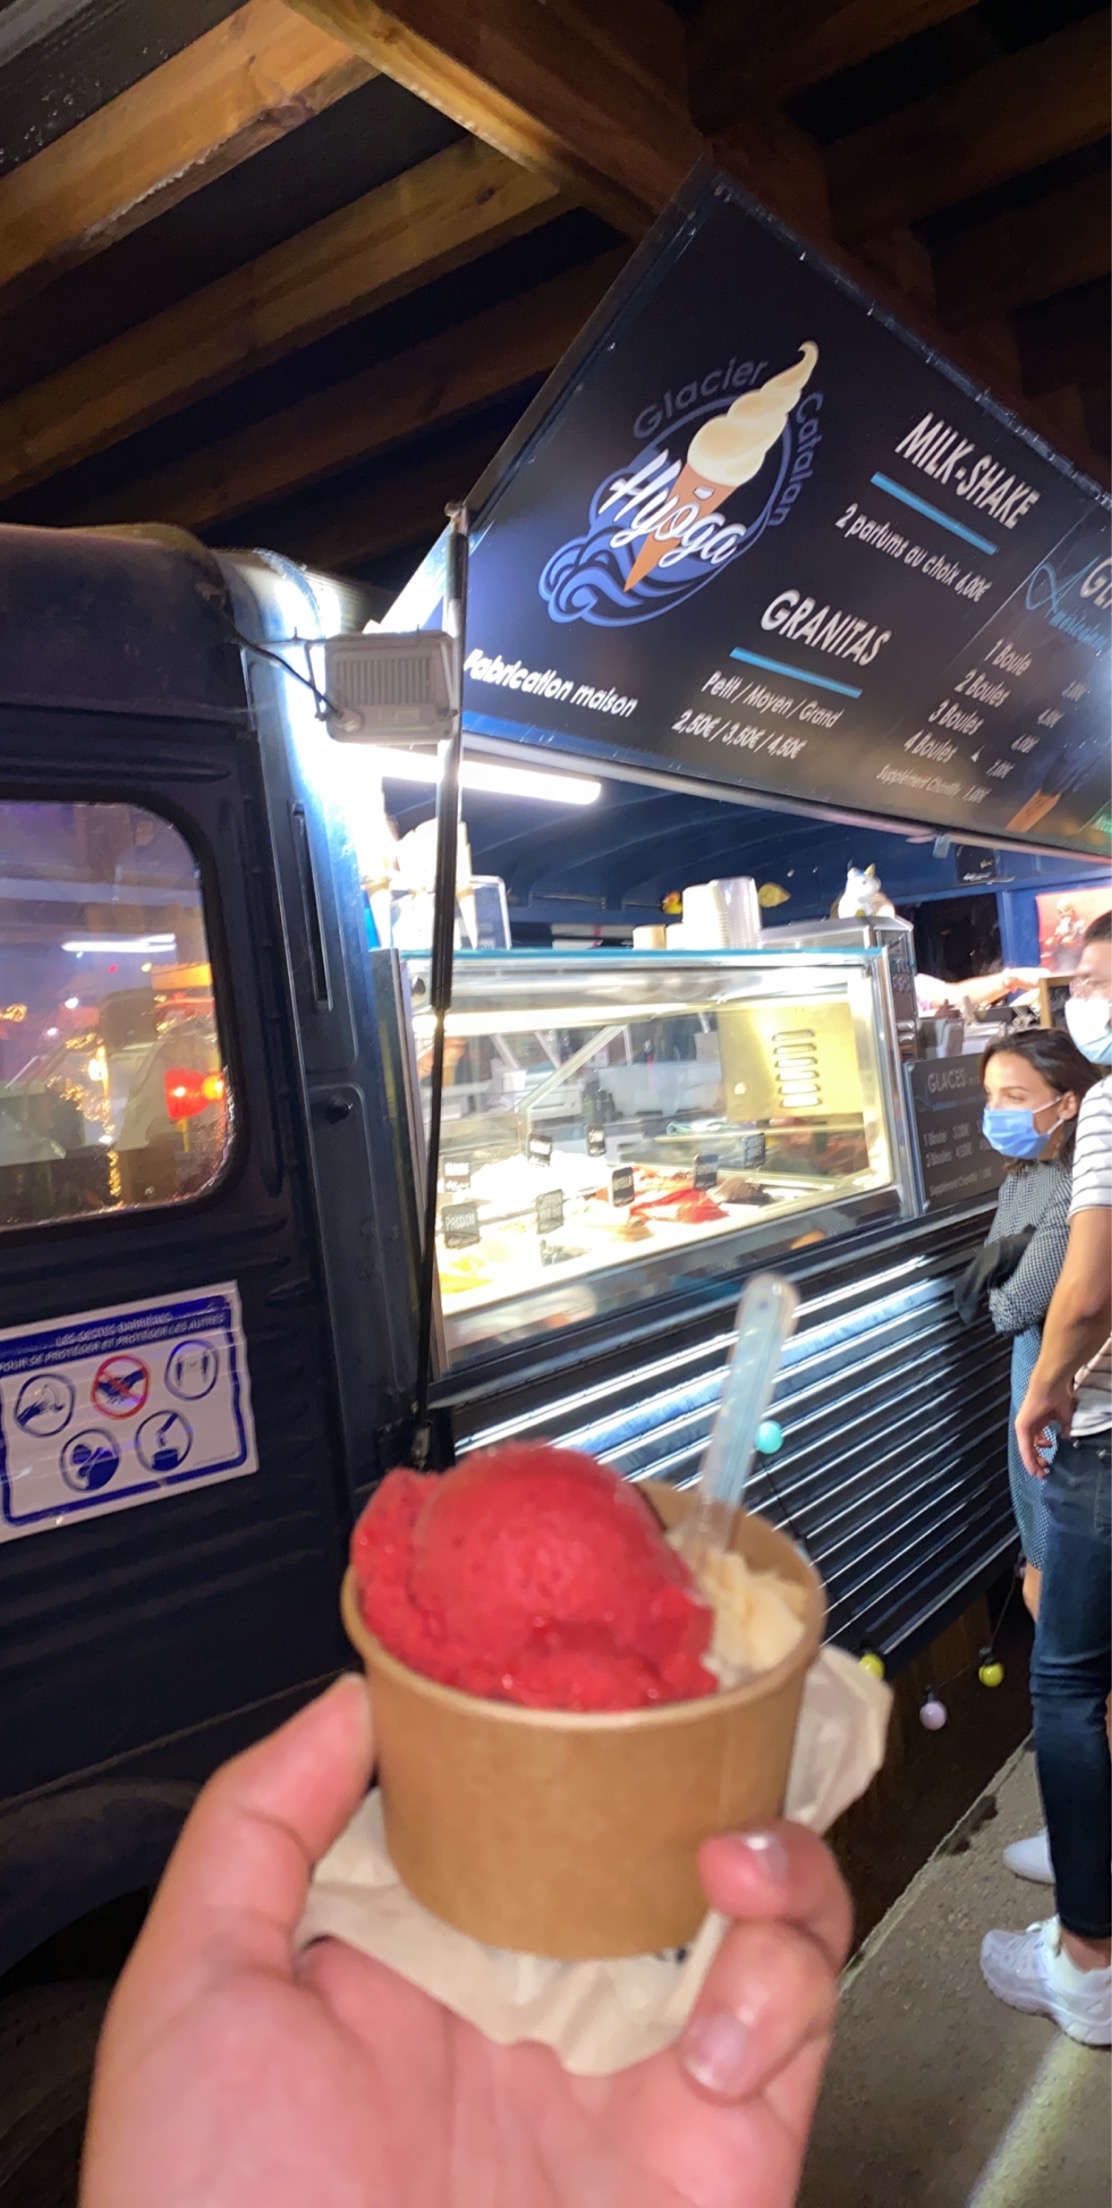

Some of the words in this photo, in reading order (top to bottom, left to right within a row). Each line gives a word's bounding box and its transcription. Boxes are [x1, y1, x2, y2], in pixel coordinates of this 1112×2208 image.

[633, 354, 770, 439] Glacier
[767, 391, 825, 527] Catalan
[894, 411, 1041, 530] MILK-SHAKE
[834, 502, 858, 529] 2
[844, 513, 910, 558] parfums
[903, 545, 929, 567] au
[921, 553, 961, 586] choix
[954, 570, 993, 602] 6,00€
[1080, 556, 1112, 609] GL
[760, 588, 892, 666] GRANITAS
[984, 637, 1004, 661] 1
[991, 641, 1033, 676] Boule
[463, 648, 575, 701] Fabrication
[569, 683, 639, 718] maison
[953, 667, 977, 692] 2
[964, 671, 1011, 708] Boules
[701, 670, 743, 700] Petit
[742, 683, 792, 715] Moyen
[798, 699, 845, 729] Grand
[928, 699, 951, 722] 3
[671, 708, 722, 738] 2,50€
[721, 721, 766, 750] 3,50€
[767, 733, 808, 760] 4,50€
[938, 702, 985, 736] Boules
[903, 729, 924, 752] 4
[911, 731, 959, 763] Boules
[927, 1067, 967, 1093] GLACES
